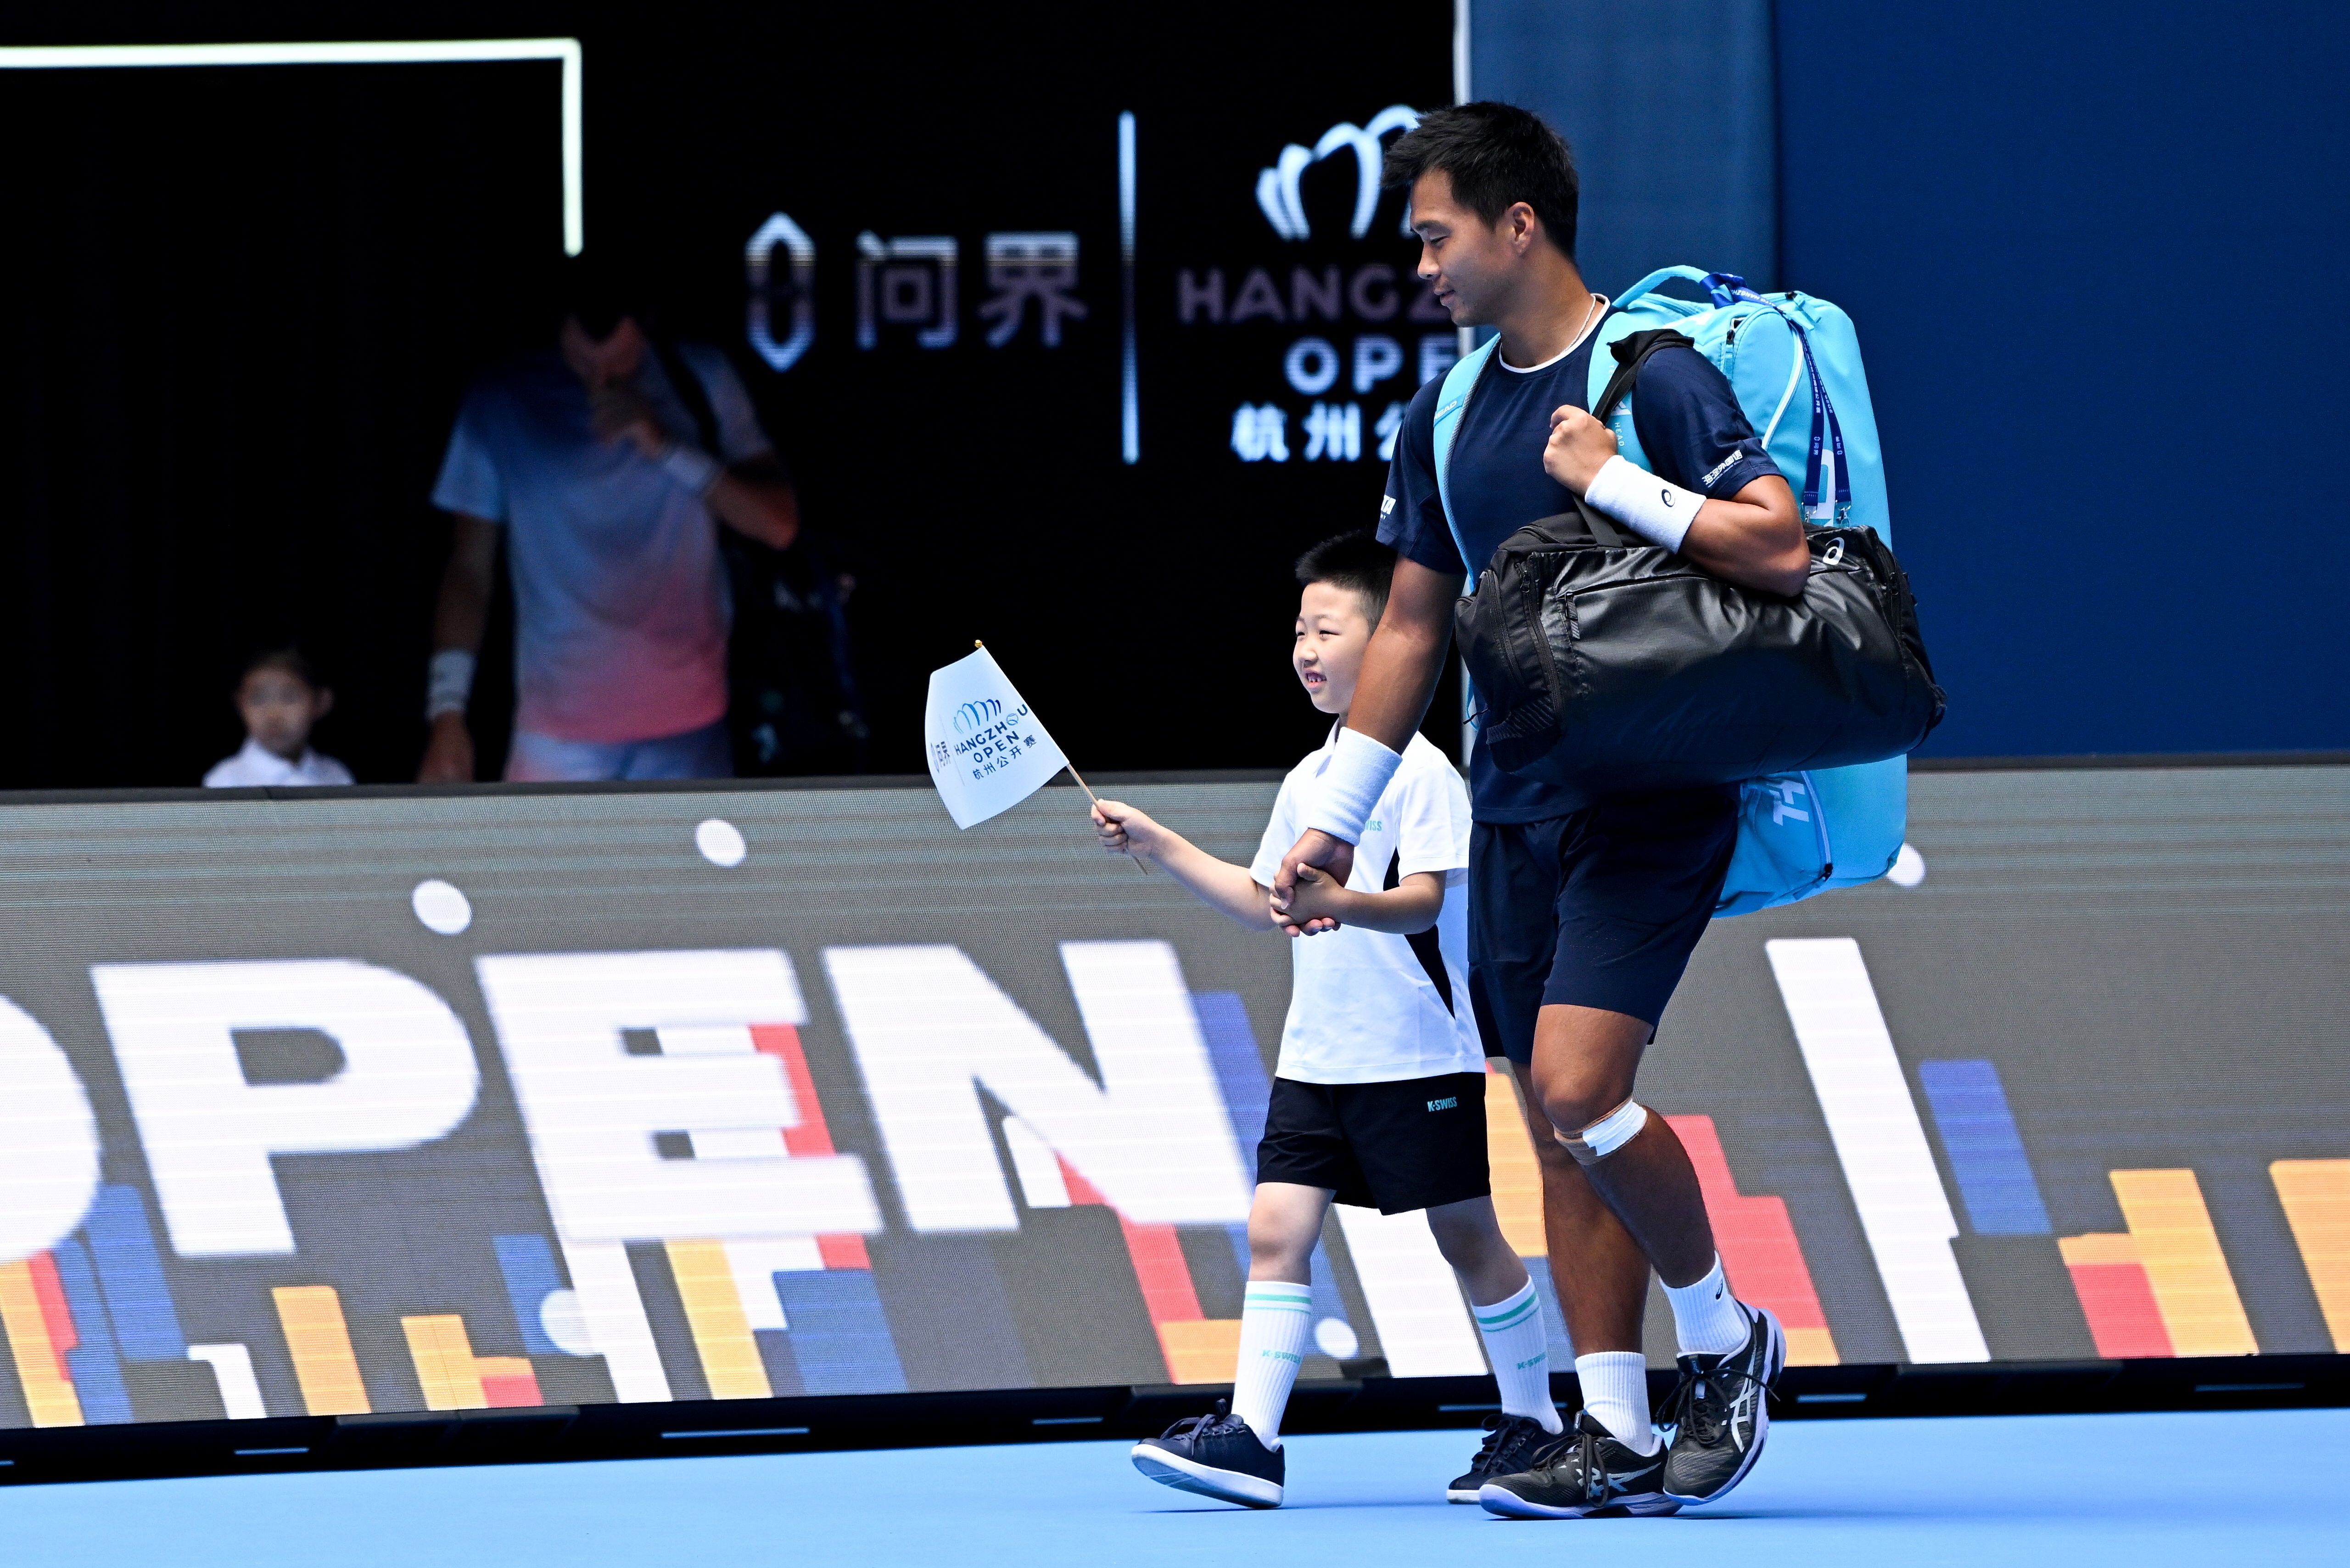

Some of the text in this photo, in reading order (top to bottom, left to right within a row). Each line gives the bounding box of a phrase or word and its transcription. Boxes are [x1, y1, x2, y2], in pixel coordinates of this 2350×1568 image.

[853, 230, 1089, 351] 问界
[1176, 263, 1451, 324] HANGZ
[1284, 331, 1458, 395] OPE
[1615, 422, 1625, 447] HEAD
[973, 734, 1037, 780] 杭州公开赛
[974, 730, 1020, 763] OPEN
[0, 940, 1260, 1261] PEN
